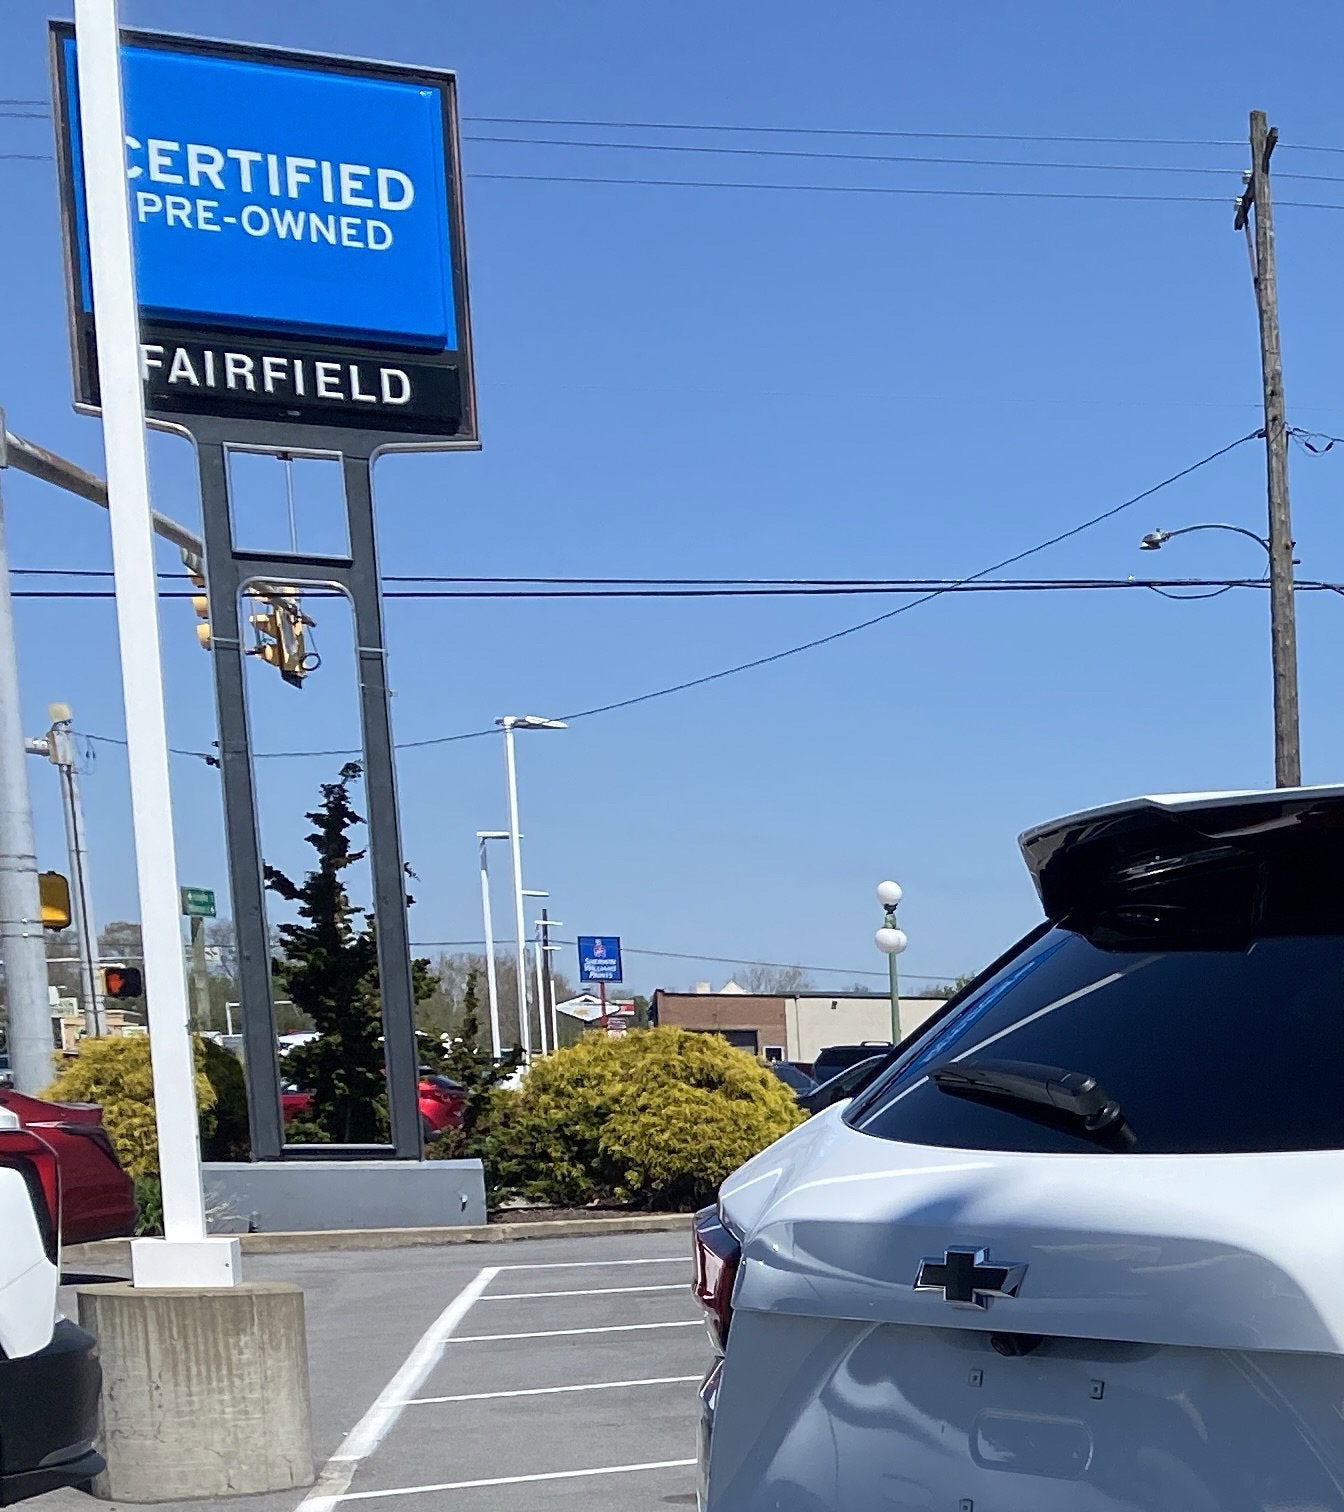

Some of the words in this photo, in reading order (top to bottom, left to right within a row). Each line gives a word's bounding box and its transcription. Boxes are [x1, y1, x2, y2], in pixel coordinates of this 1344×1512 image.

[124, 135, 415, 212] CERTIFIED
[136, 191, 393, 251] PRE-OWNED
[139, 343, 412, 406] FAIRFIELD
